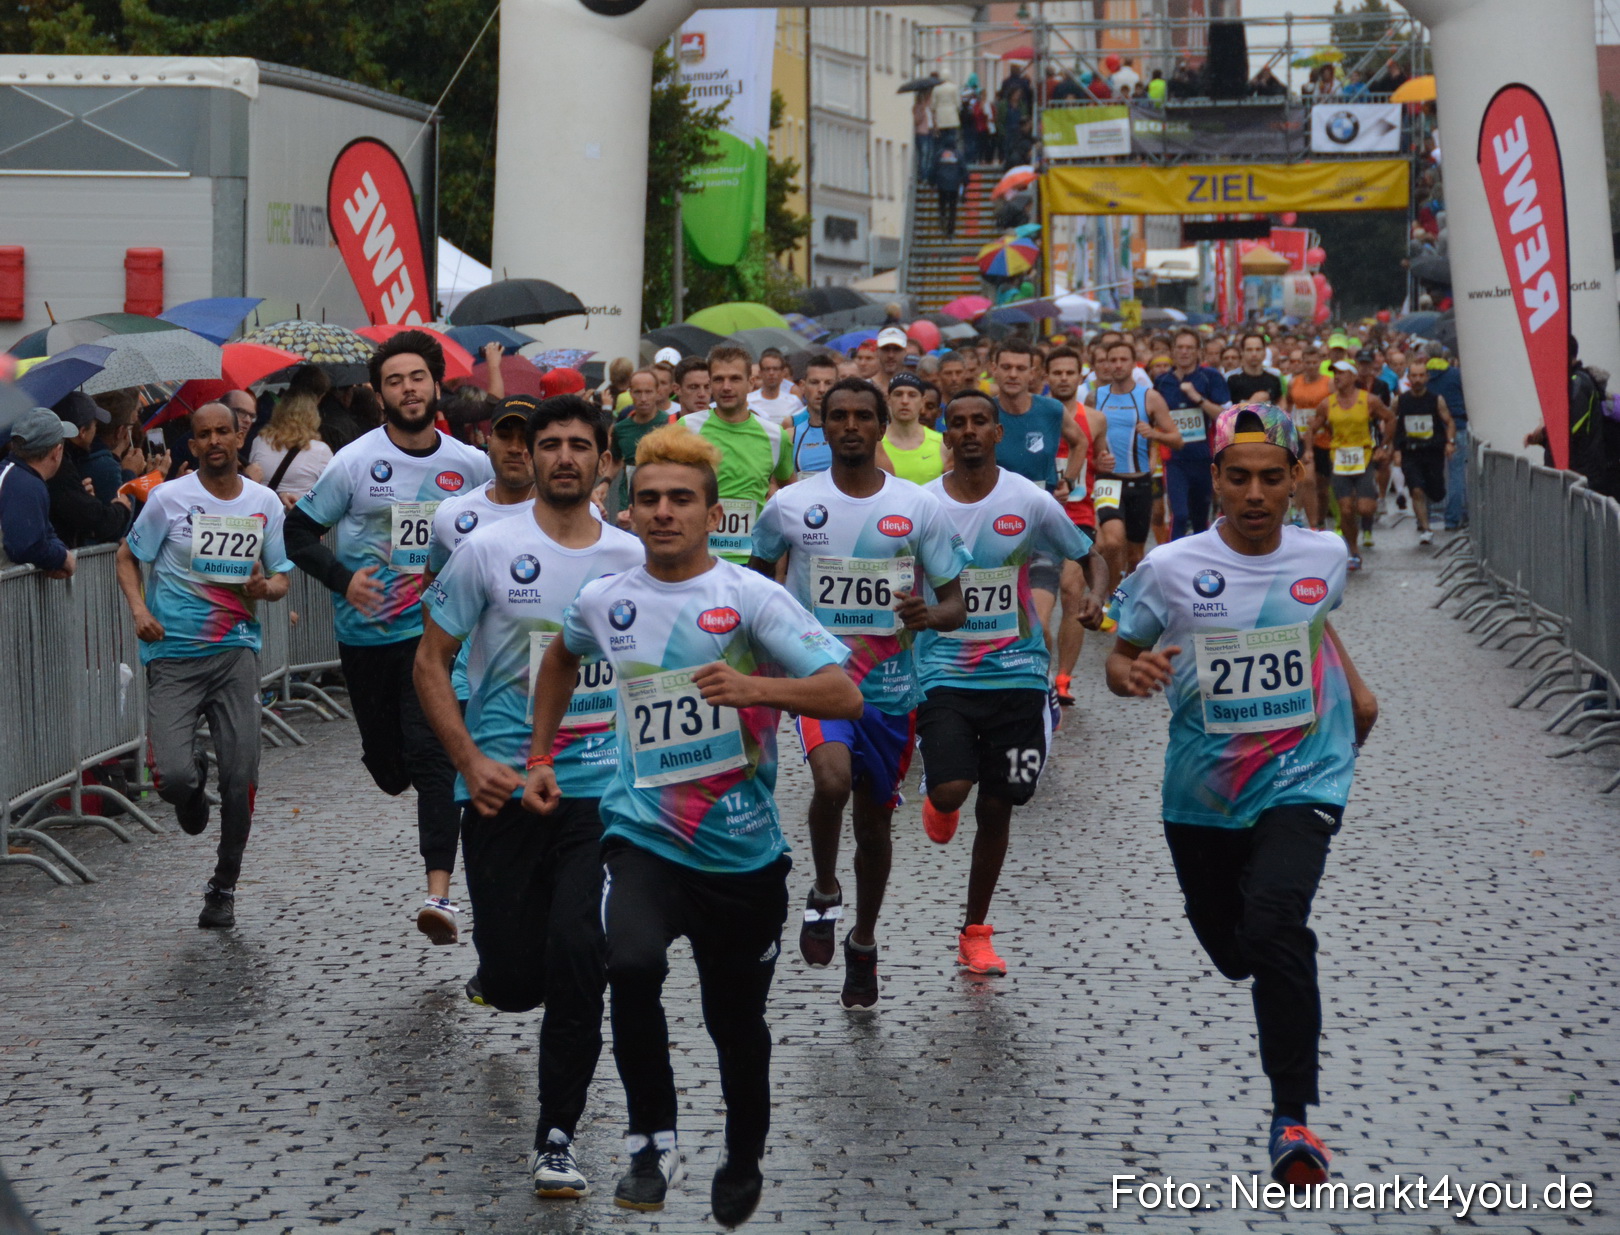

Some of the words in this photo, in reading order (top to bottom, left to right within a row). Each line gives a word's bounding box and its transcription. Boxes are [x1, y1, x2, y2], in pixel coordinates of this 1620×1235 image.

[1187, 174, 1266, 202] ZIEL
[1493, 115, 1559, 333] REWE
[1414, 422, 1425, 431] 14
[1341, 453, 1359, 464] 319
[440, 476, 461, 487] Hervis
[1095, 486, 1112, 498] 00
[716, 513, 749, 534] 001
[882, 521, 909, 532] Hervis
[998, 520, 1022, 530] Hervis
[400, 519, 429, 546] 26
[200, 531, 257, 557] 2722
[710, 538, 741, 548] Michael
[204, 562, 248, 576] Abdivisag
[508, 589, 541, 597] PARTL
[819, 575, 891, 606] 2766
[1296, 585, 1324, 598] Hervis
[964, 584, 1012, 612] 679
[1193, 603, 1227, 611] PARTL
[704, 613, 736, 625] Hervis
[834, 612, 874, 624] Ahmad
[610, 635, 636, 645] PARTL
[1246, 628, 1300, 645] BOCK
[1204, 644, 1240, 652] NeuerMarkt
[882, 661, 900, 674] 17.
[1210, 650, 1303, 695] 2736
[1213, 703, 1258, 720] Sayed
[1263, 697, 1306, 716] Bashir
[660, 744, 712, 769] Ahmed
[1006, 748, 1040, 784] 13
[722, 792, 749, 812] 17.
